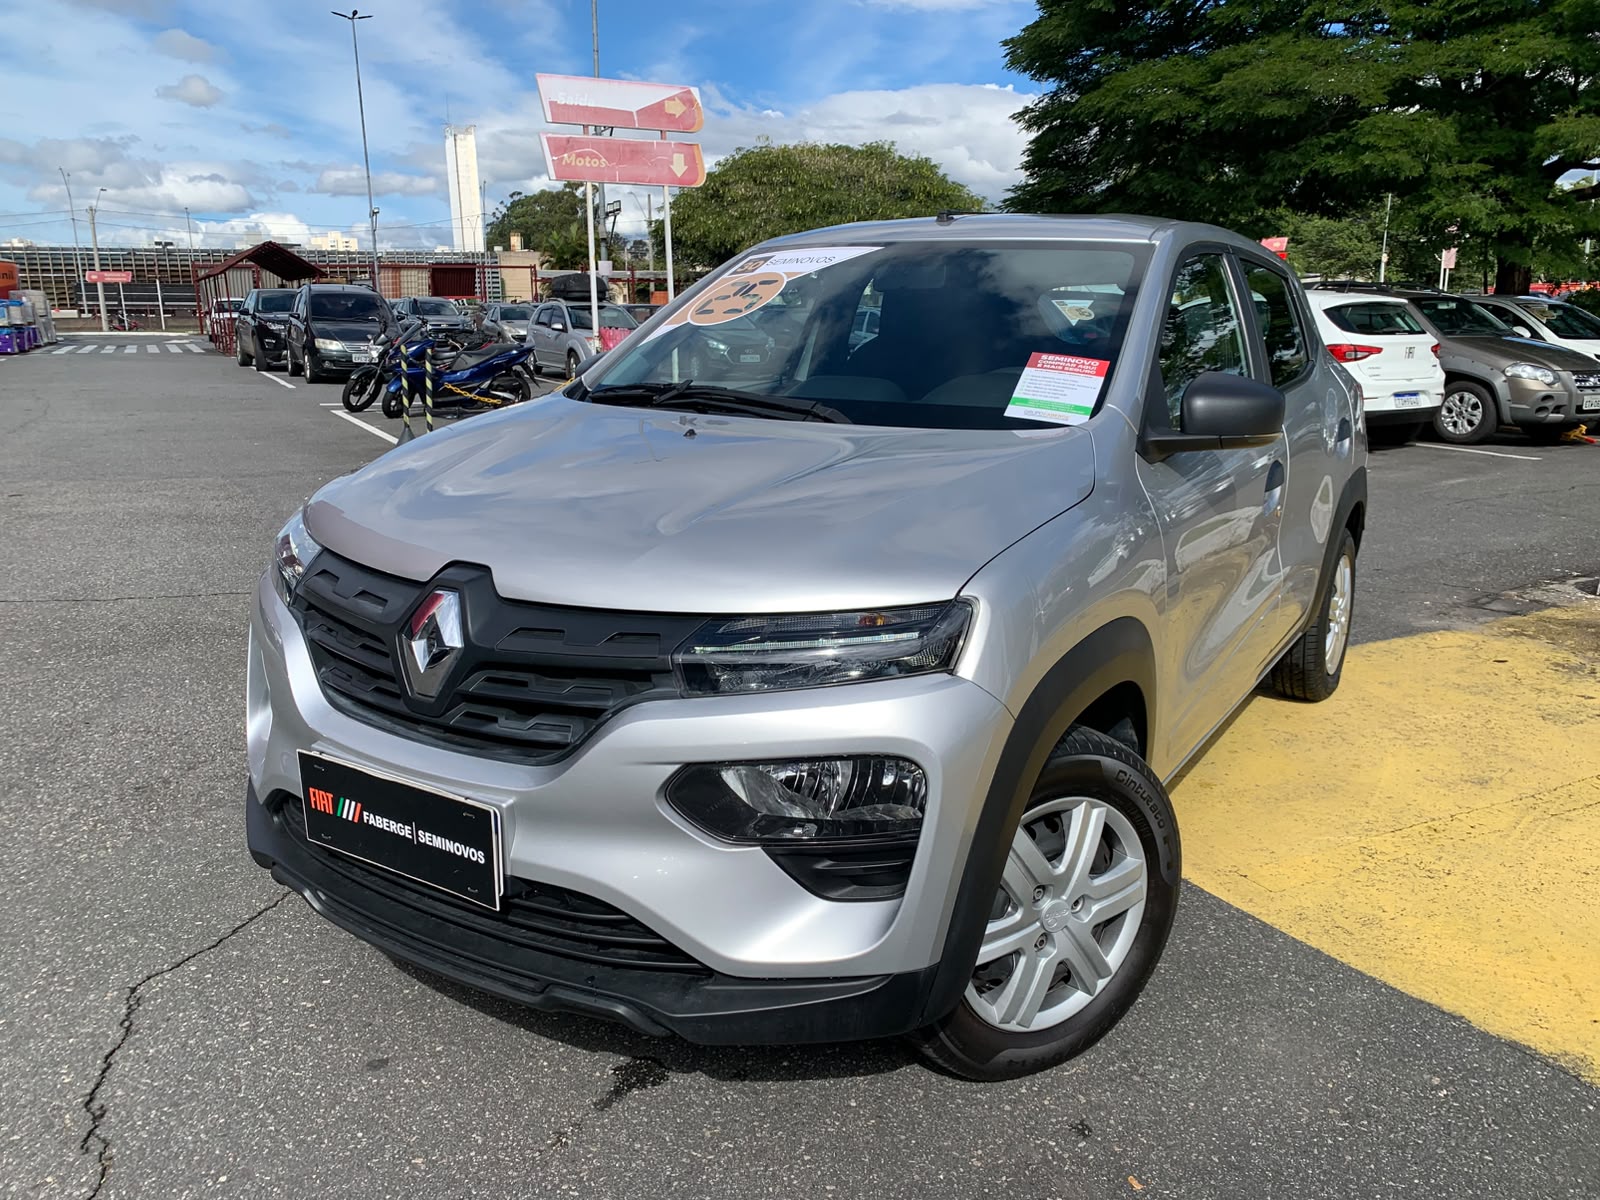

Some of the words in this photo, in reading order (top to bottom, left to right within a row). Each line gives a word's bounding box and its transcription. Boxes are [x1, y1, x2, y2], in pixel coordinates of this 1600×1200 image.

[562, 153, 606, 168] Motos
[766, 256, 835, 266] SEMINOVOS
[1041, 355, 1099, 366] SEMINOVO
[308, 787, 334, 815] FIAT
[363, 810, 413, 839] FABERGE
[418, 830, 486, 864] SEMINOVOS
